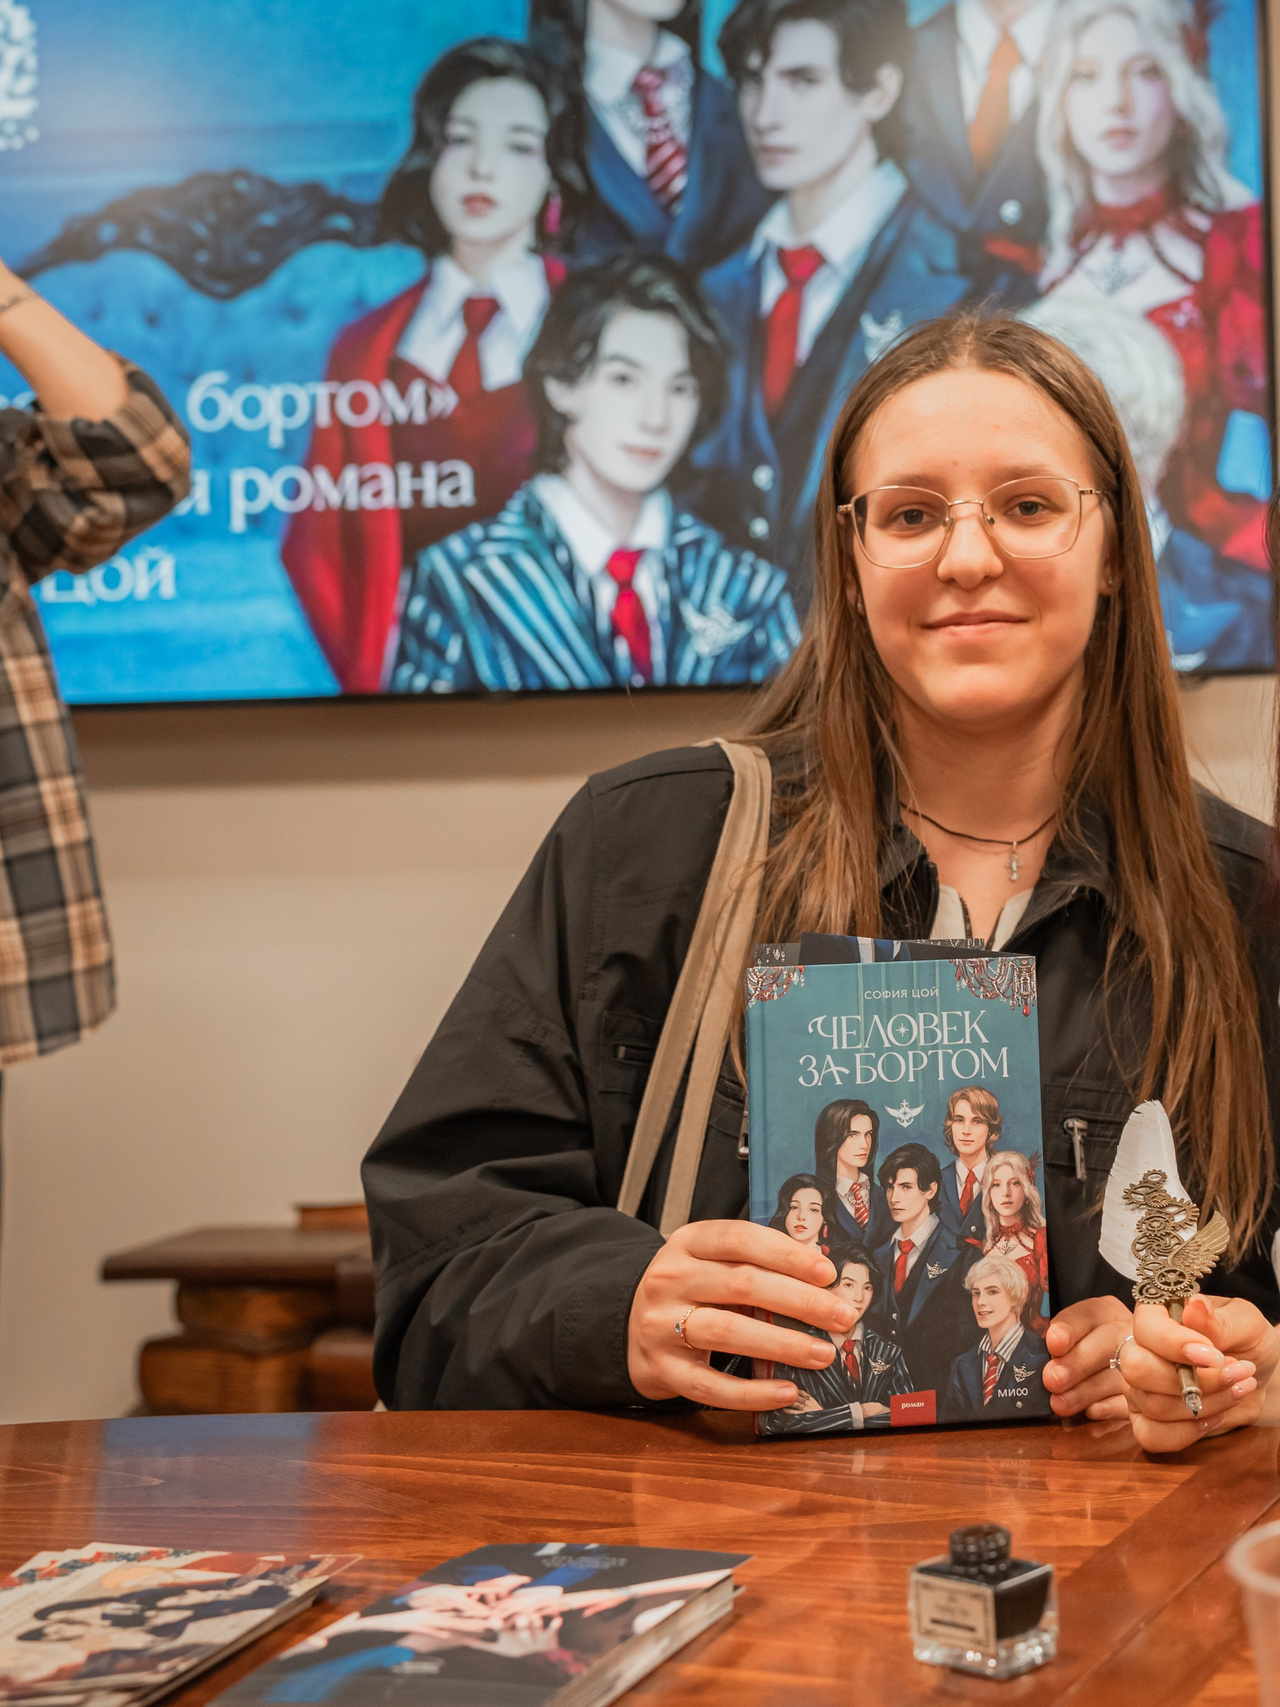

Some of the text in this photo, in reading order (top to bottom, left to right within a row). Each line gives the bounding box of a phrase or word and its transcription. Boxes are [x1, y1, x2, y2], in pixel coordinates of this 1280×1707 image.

[187, 370, 459, 448] бортом»
[230, 459, 476, 533] романа
[864, 986, 939, 1000] СОФИЯ ЦОЙ
[808, 1009, 989, 1050] ЧЕЛОВЕК
[798, 1046, 1009, 1087] ЗА БОРТОМ
[901, 1401, 925, 1411] роман
